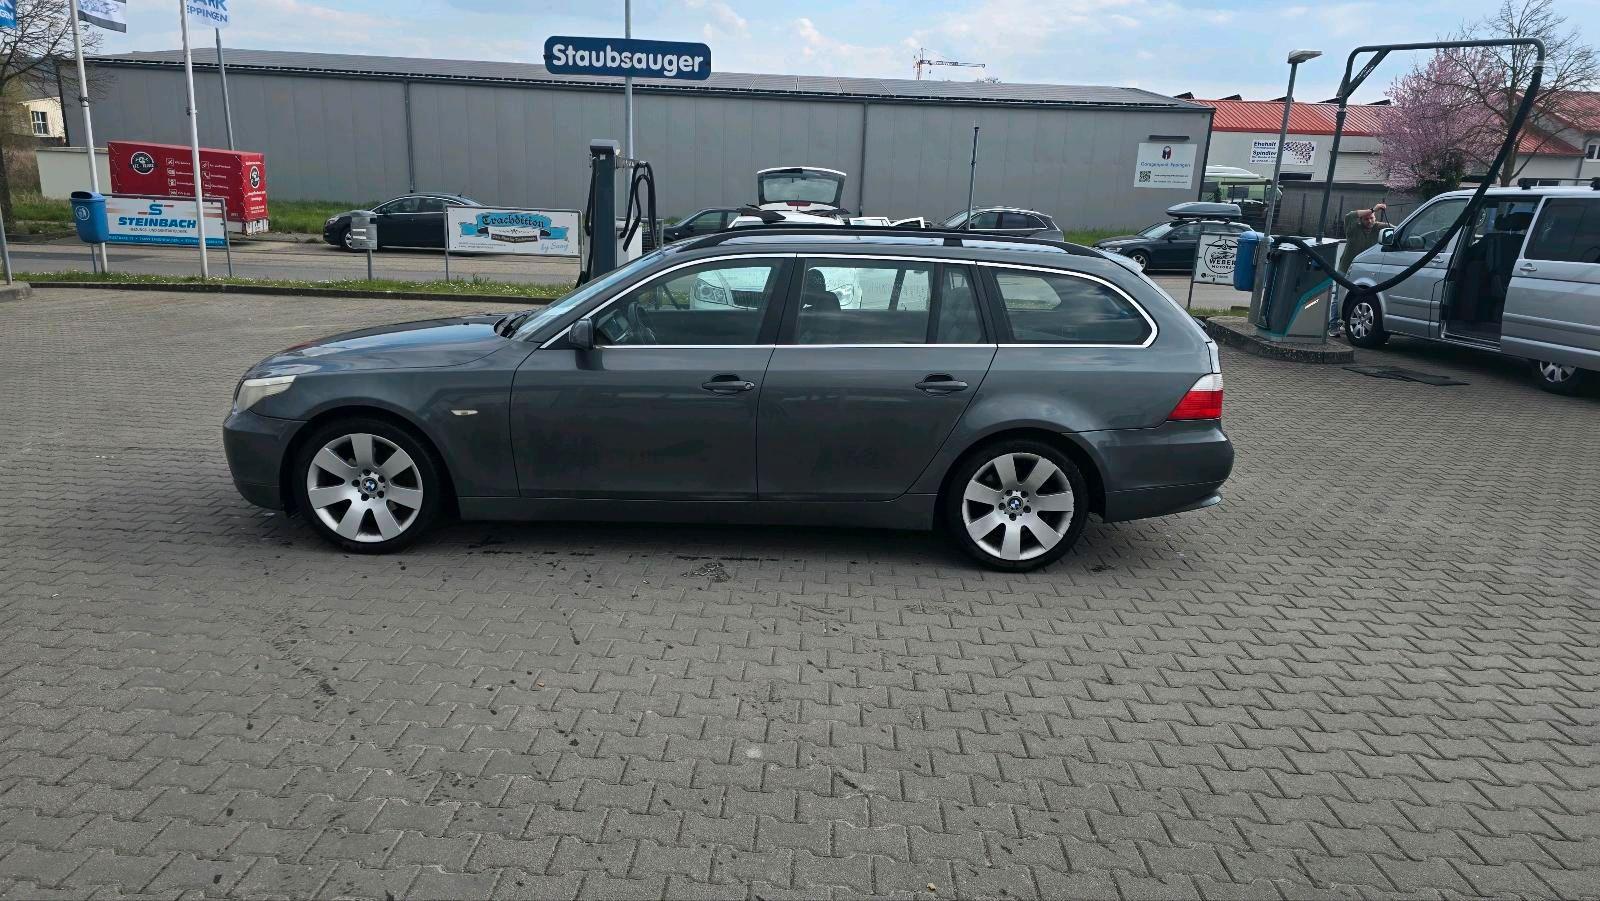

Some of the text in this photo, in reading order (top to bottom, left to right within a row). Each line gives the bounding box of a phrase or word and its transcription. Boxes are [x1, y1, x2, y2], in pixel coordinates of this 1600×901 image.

[552, 43, 704, 77] Staubsauger
[118, 216, 197, 229] STEINBACH
[1209, 258, 1236, 266] WEBER
